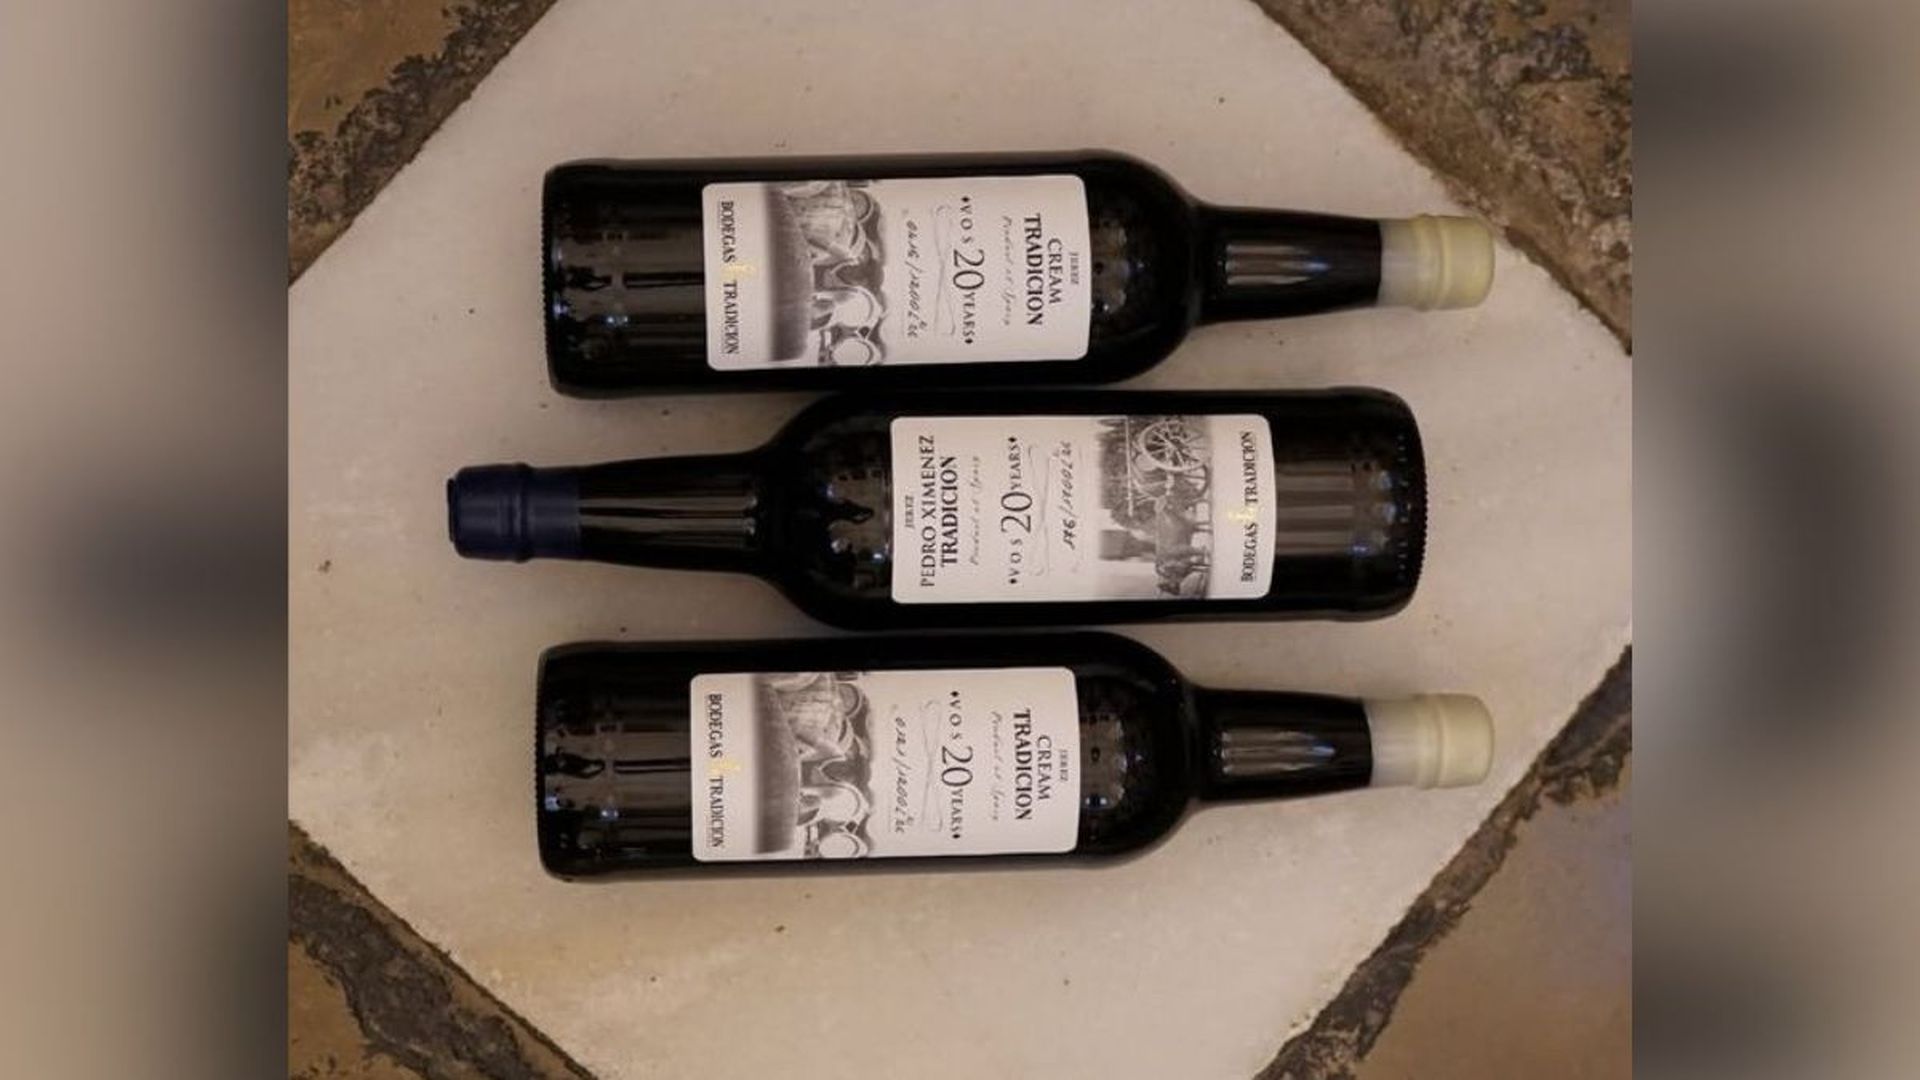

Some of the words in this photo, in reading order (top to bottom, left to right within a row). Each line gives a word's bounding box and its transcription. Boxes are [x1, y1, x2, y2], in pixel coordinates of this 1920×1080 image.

[720, 200, 738, 264] BODEGAS
[952, 248, 985, 291] 20
[1024, 212, 1044, 326] TRADICION
[1047, 238, 1063, 304] CREAM
[722, 280, 740, 355] TRADICION
[961, 291, 976, 337] YEARS
[918, 435, 937, 520] XIMENEZ
[1008, 444, 1022, 490] YEARS
[1239, 431, 1259, 506] TRADICION
[940, 455, 958, 568] TRADICION
[1000, 491, 1032, 533] 20
[920, 525, 937, 587] PEDRO
[1240, 522, 1259, 582] BODEGAS
[708, 693, 724, 759] BODEGAS
[940, 745, 974, 787] 20
[1013, 708, 1033, 821] TRADICION
[1036, 734, 1052, 800] CREAM
[709, 775, 725, 848] TRADICION
[950, 788, 964, 832] YEARS
